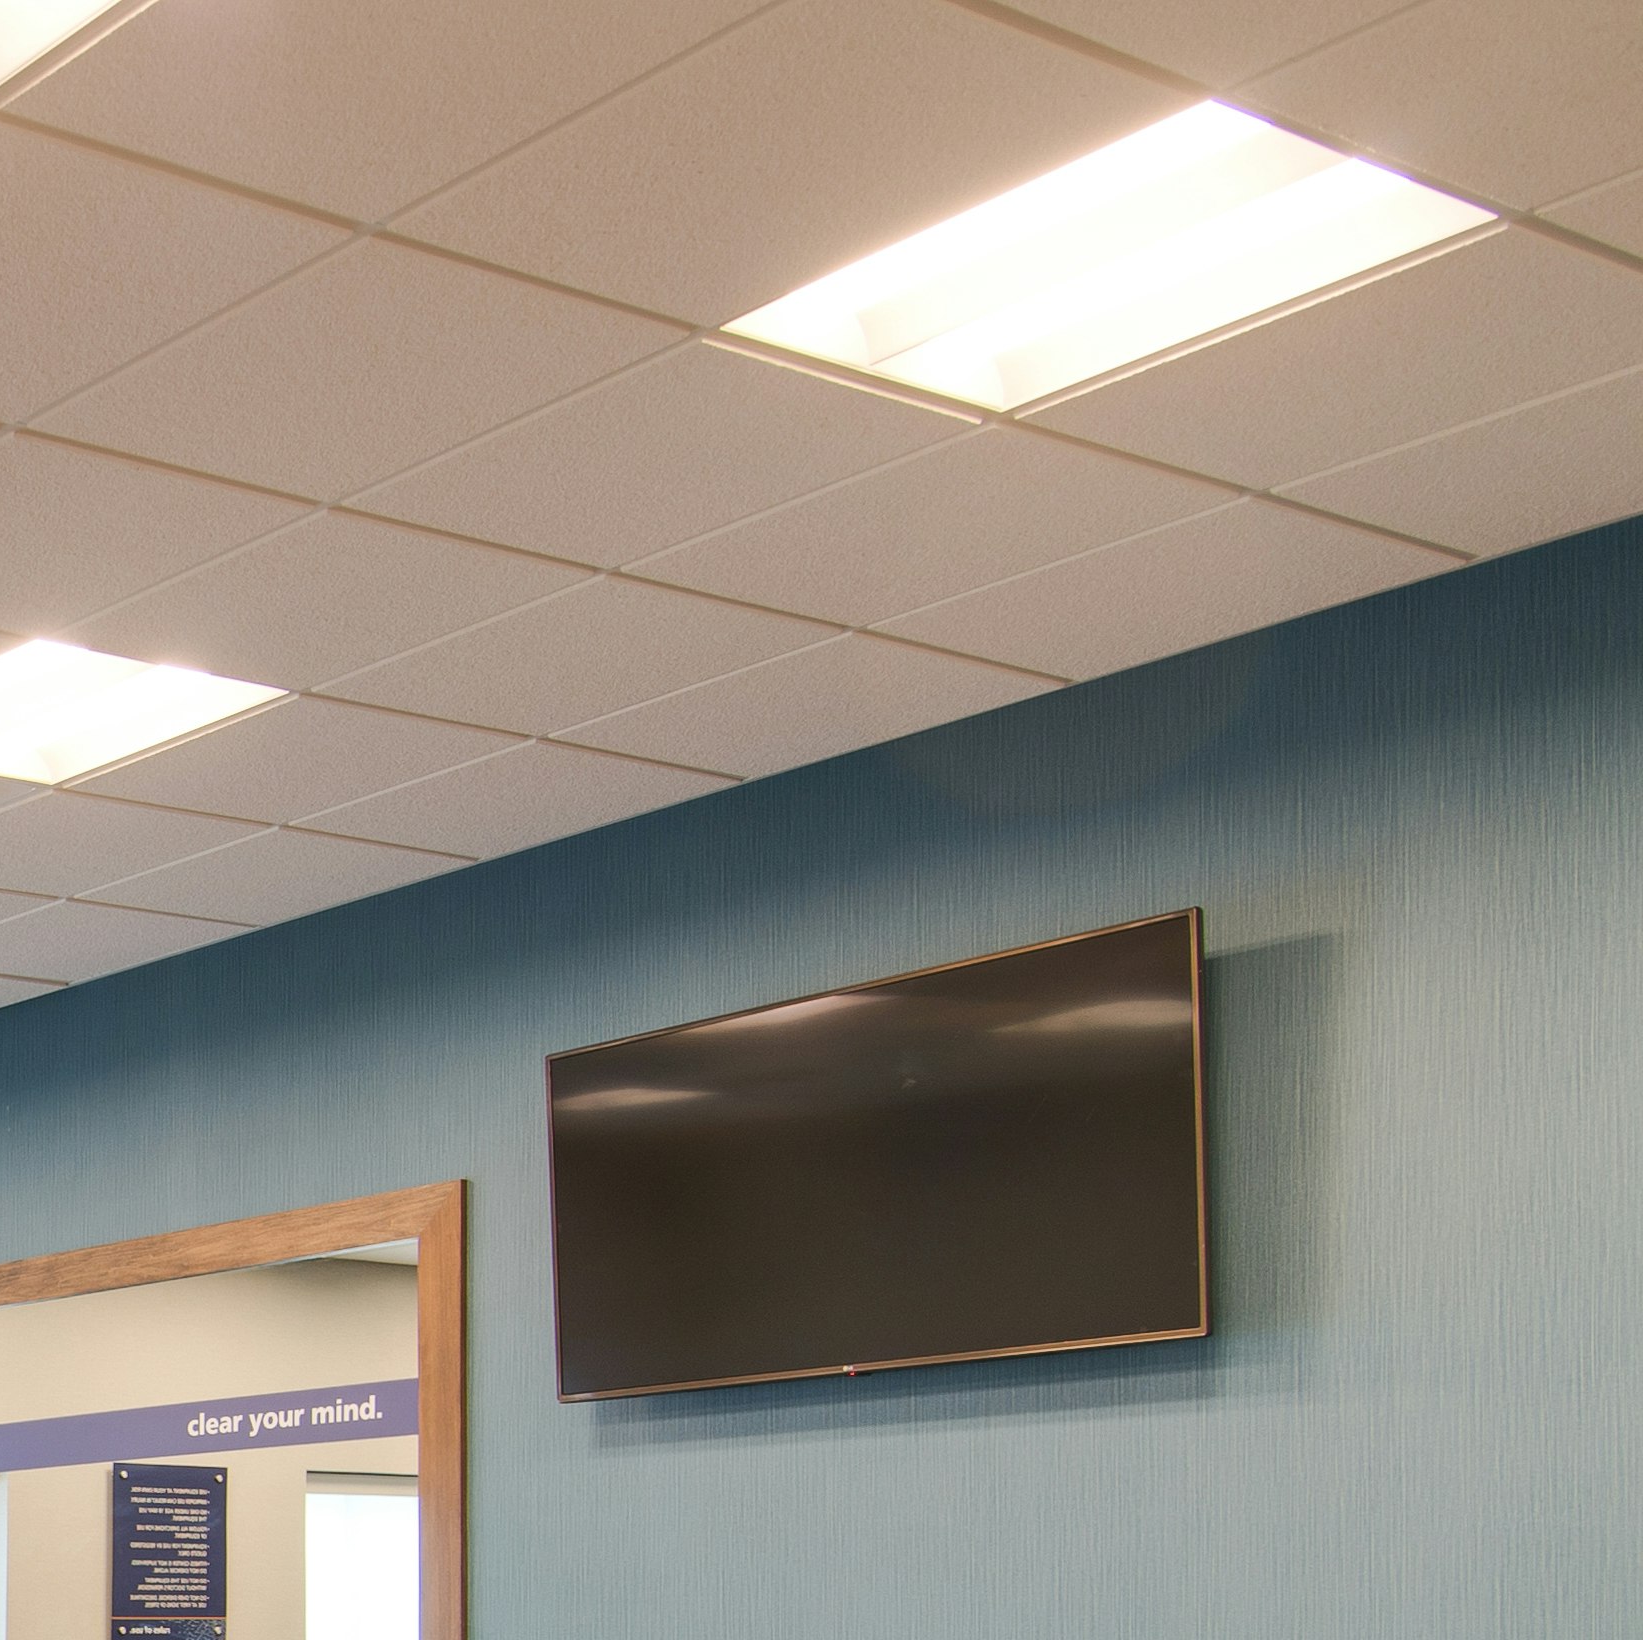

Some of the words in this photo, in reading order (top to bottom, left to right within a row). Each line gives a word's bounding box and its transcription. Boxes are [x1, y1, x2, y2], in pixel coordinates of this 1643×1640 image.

[188, 1413, 243, 1436] clear
[249, 1409, 304, 1437] your
[312, 1395, 382, 1424] mind.
